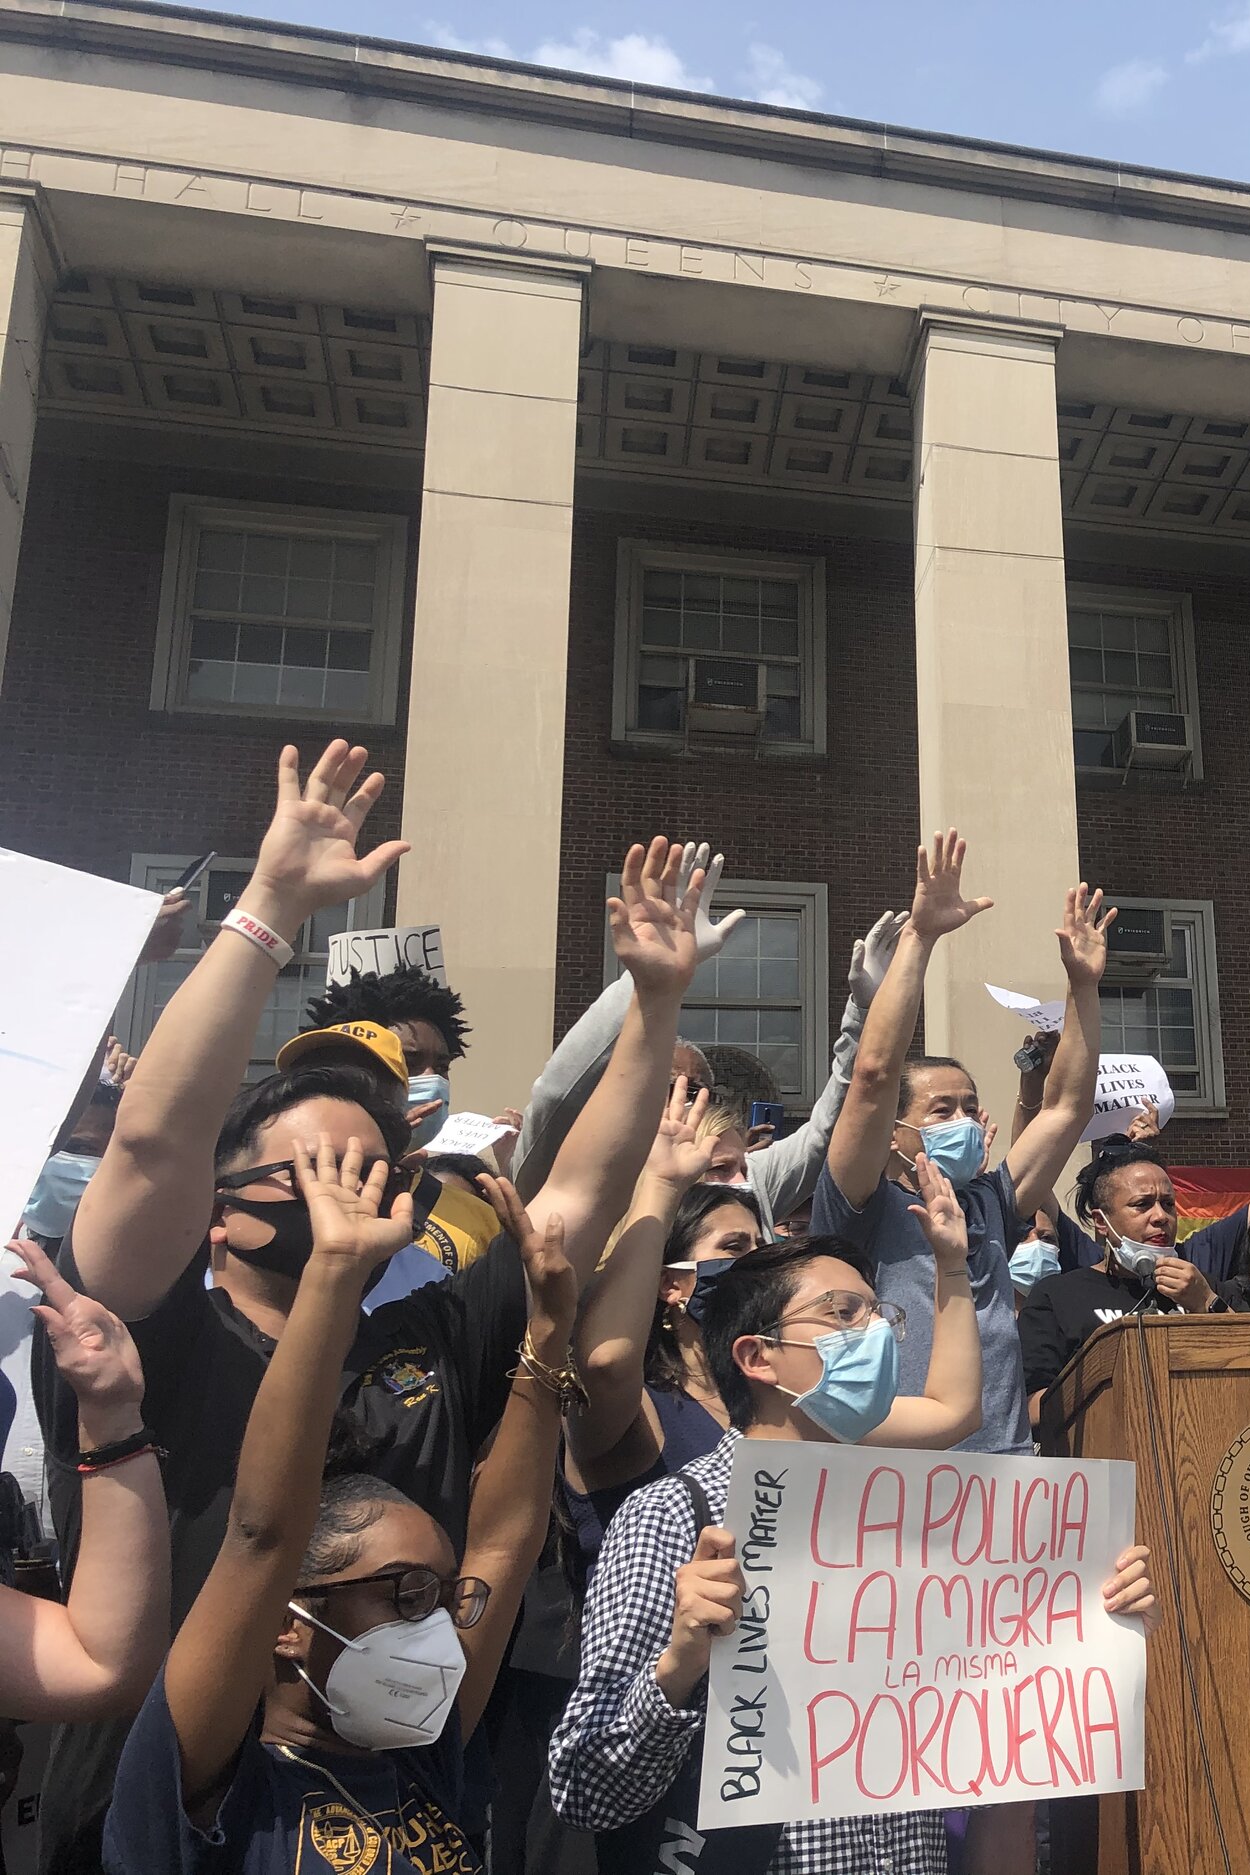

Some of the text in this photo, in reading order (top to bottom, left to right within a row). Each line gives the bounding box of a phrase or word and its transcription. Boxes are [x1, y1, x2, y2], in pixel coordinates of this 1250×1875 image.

[112, 163, 324, 220] HALL
[492, 217, 815, 290] QUEENS
[961, 284, 1123, 331] CITY
[1176, 316, 1250, 348] OF
[236, 916, 279, 950] PRIDE
[329, 928, 444, 977] JUSTICE
[338, 1024, 378, 1041] ACP
[1093, 1093, 1161, 1115] MATTR
[1099, 1078, 1145, 1095] LIVES
[1239, 1483, 1250, 1501] OF
[810, 1464, 1089, 1569] LA POLICIA
[720, 1468, 789, 1802] BLACK LIVES MATTER
[803, 1566, 1085, 1665] LA MIGRA
[885, 1650, 1019, 1689] LA MISMA
[805, 1664, 1124, 1804] PORQUERIA
